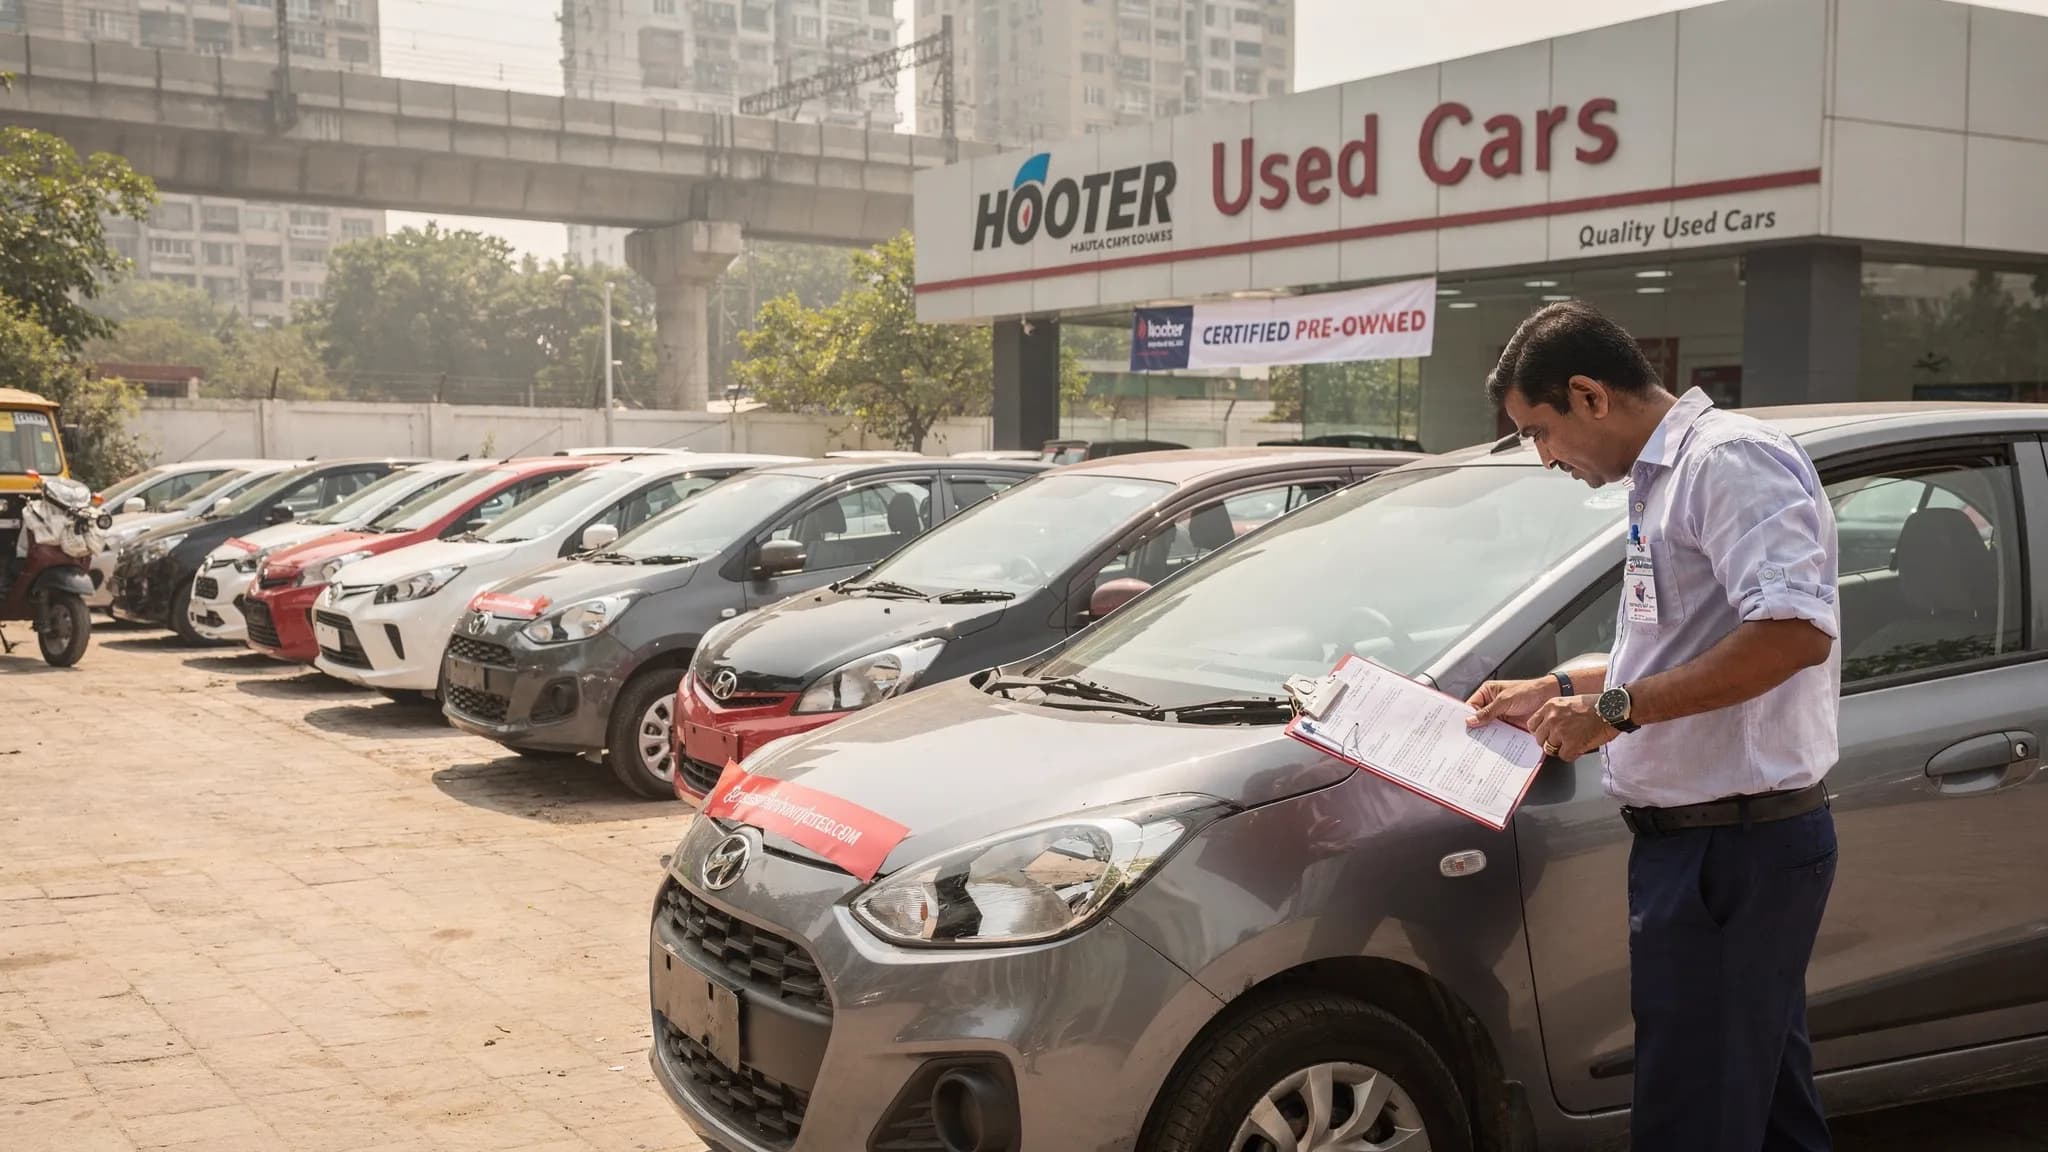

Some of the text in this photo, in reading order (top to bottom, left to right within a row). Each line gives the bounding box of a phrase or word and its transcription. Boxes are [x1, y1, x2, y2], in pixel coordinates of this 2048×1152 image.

[1212, 97, 1619, 217] Used Cars
[973, 161, 1178, 251] HOOTER
[1579, 208, 1777, 250] Quality Used Cars
[1202, 309, 1427, 346] CERTIFIED PRE-OWNED
